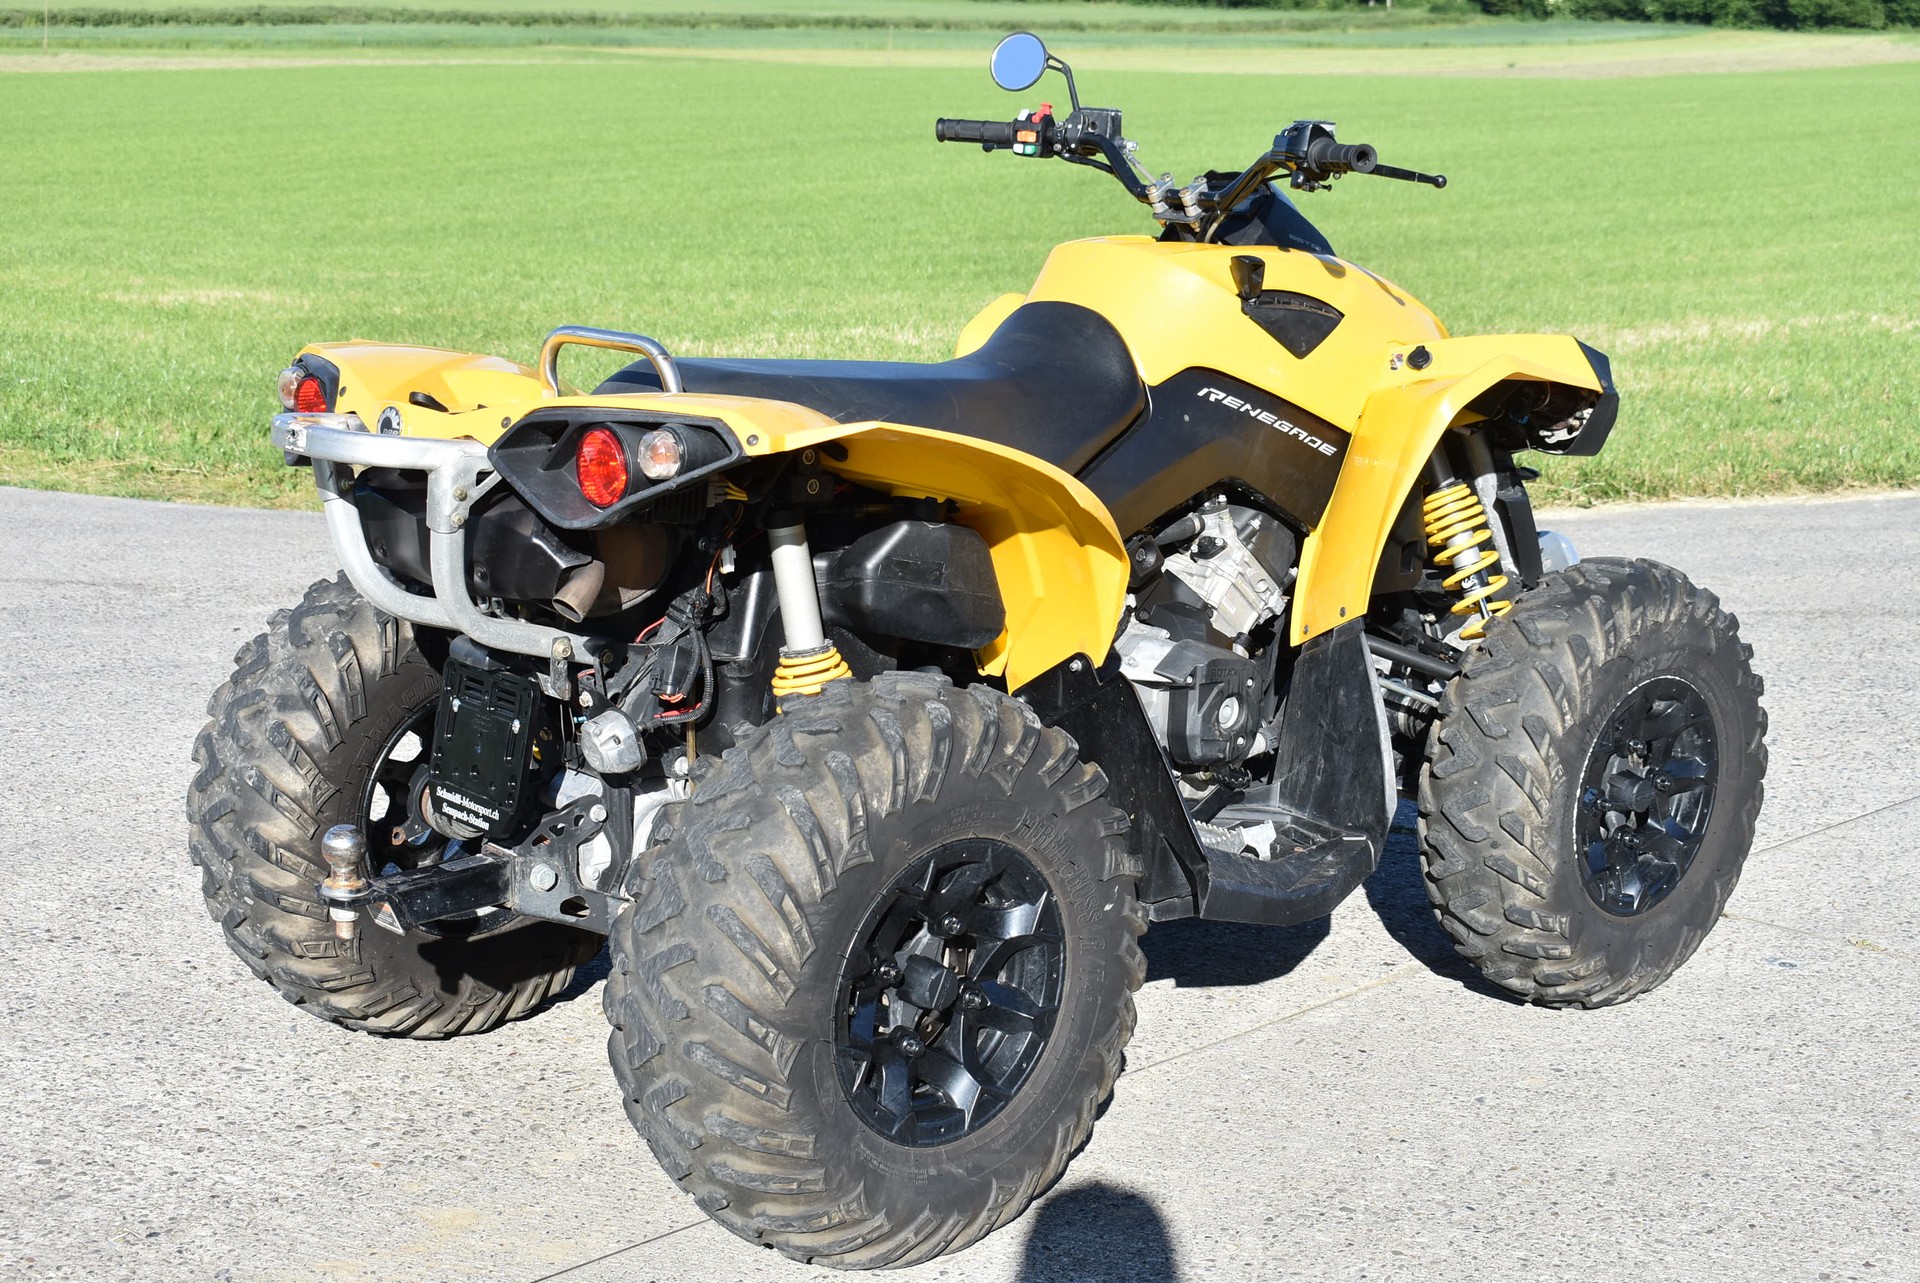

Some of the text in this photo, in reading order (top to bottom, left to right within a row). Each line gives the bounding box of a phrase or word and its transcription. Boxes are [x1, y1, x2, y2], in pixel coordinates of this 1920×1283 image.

[1197, 387, 1338, 457] RENEGADE
[1210, 666, 1239, 678] ROTAX
[442, 802, 490, 831] Sempach-Station
